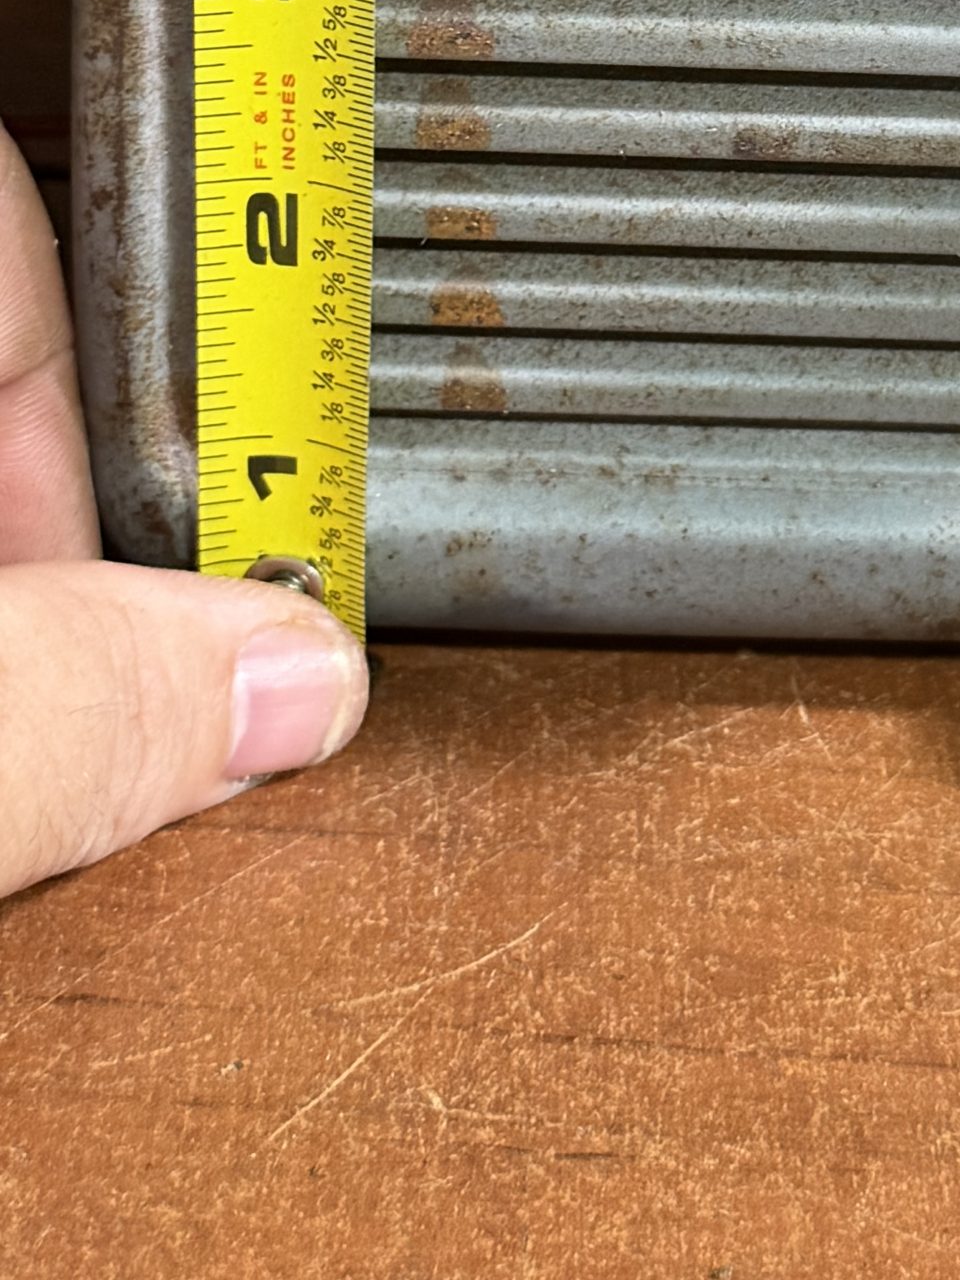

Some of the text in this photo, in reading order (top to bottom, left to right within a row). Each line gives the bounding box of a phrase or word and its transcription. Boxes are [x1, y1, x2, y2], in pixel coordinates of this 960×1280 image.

[322, 5, 348, 31] 5/8
[312, 38, 338, 63] 1/2
[322, 75, 347, 100] 3/8
[254, 72, 268, 169] FT & IN
[282, 73, 296, 170] INCHES
[312, 109, 337, 130] 1/4
[322, 141, 347, 164] 1/8
[246, 192, 298, 267] 2
[321, 206, 346, 229] 7/8
[312, 238, 336, 262] 3/4
[321, 272, 346, 296] 5/8
[312, 302, 336, 326] 1/2
[321, 338, 344, 362] 3/8
[311, 370, 334, 391] 1/4
[320, 402, 344, 424] 1/8
[247, 454, 298, 502] 1
[319, 465, 343, 487] 7/8
[310, 494, 333, 518] 3/4
[319, 528, 342, 549] 5/8
